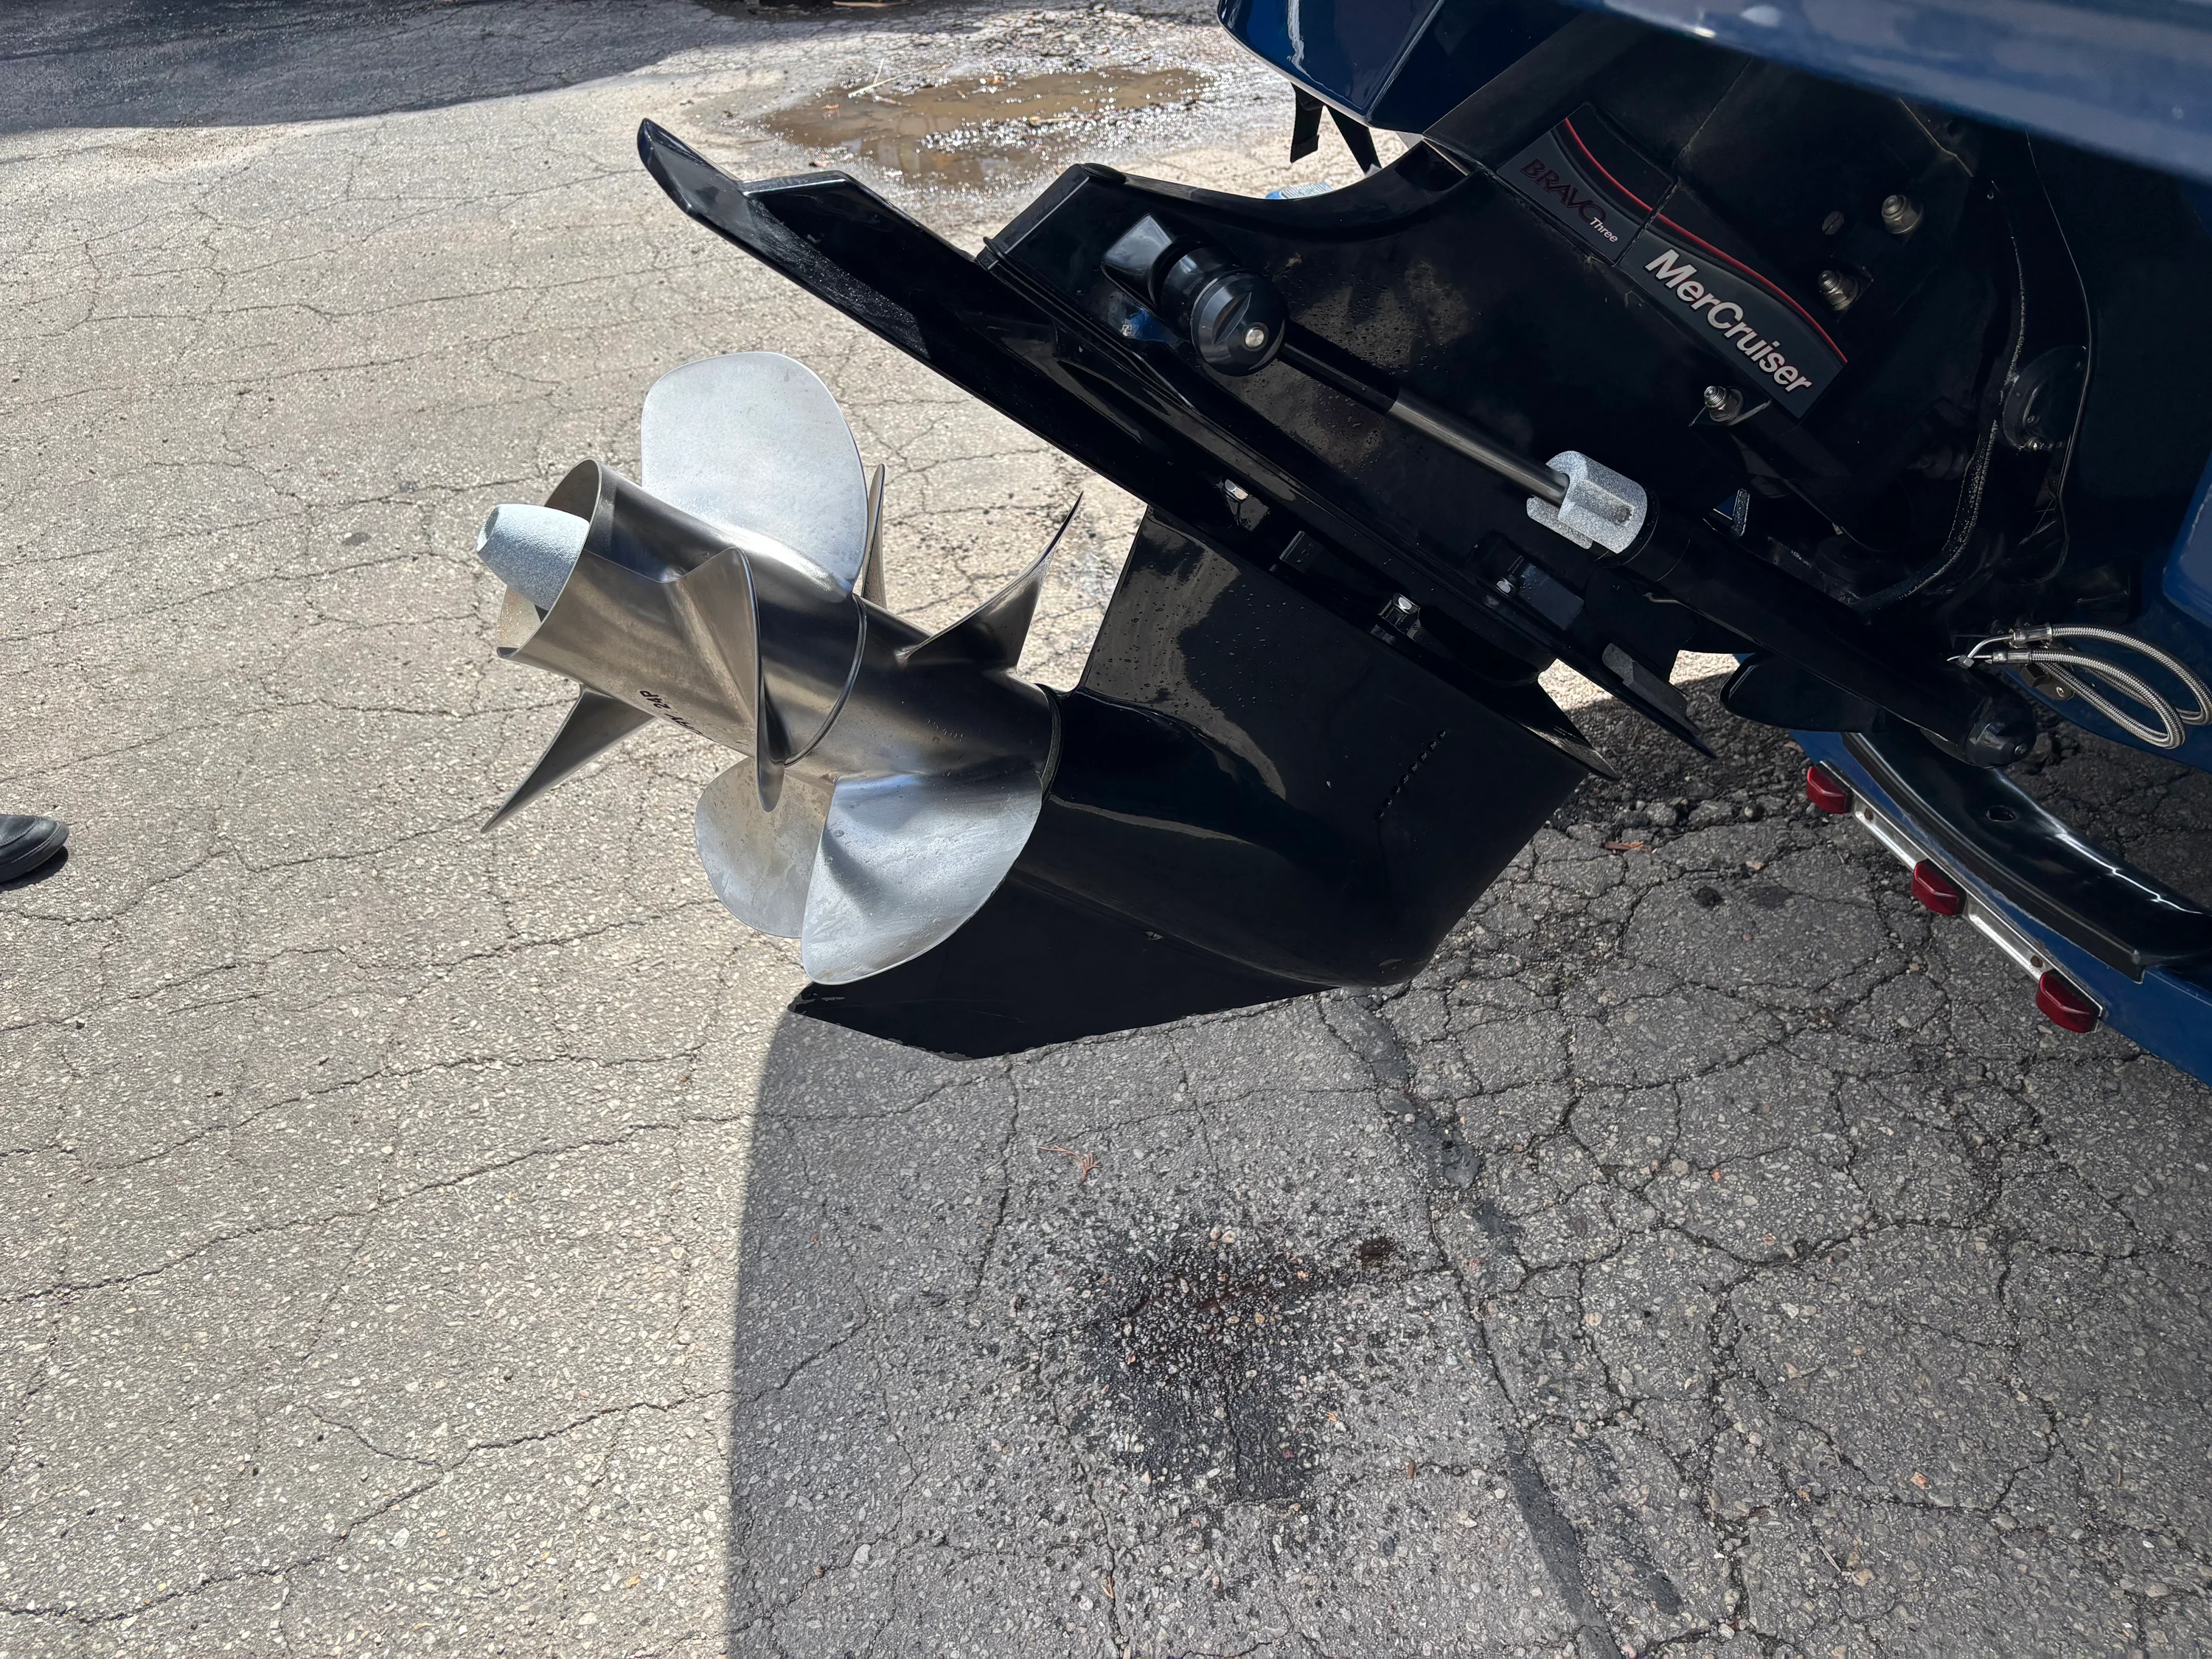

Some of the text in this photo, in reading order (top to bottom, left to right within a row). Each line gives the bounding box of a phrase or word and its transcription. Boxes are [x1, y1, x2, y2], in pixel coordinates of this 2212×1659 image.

[1520, 159, 1618, 243] BRAVO Three
[1644, 248, 1812, 393] MerCruiser
[639, 690, 671, 709] 24P
